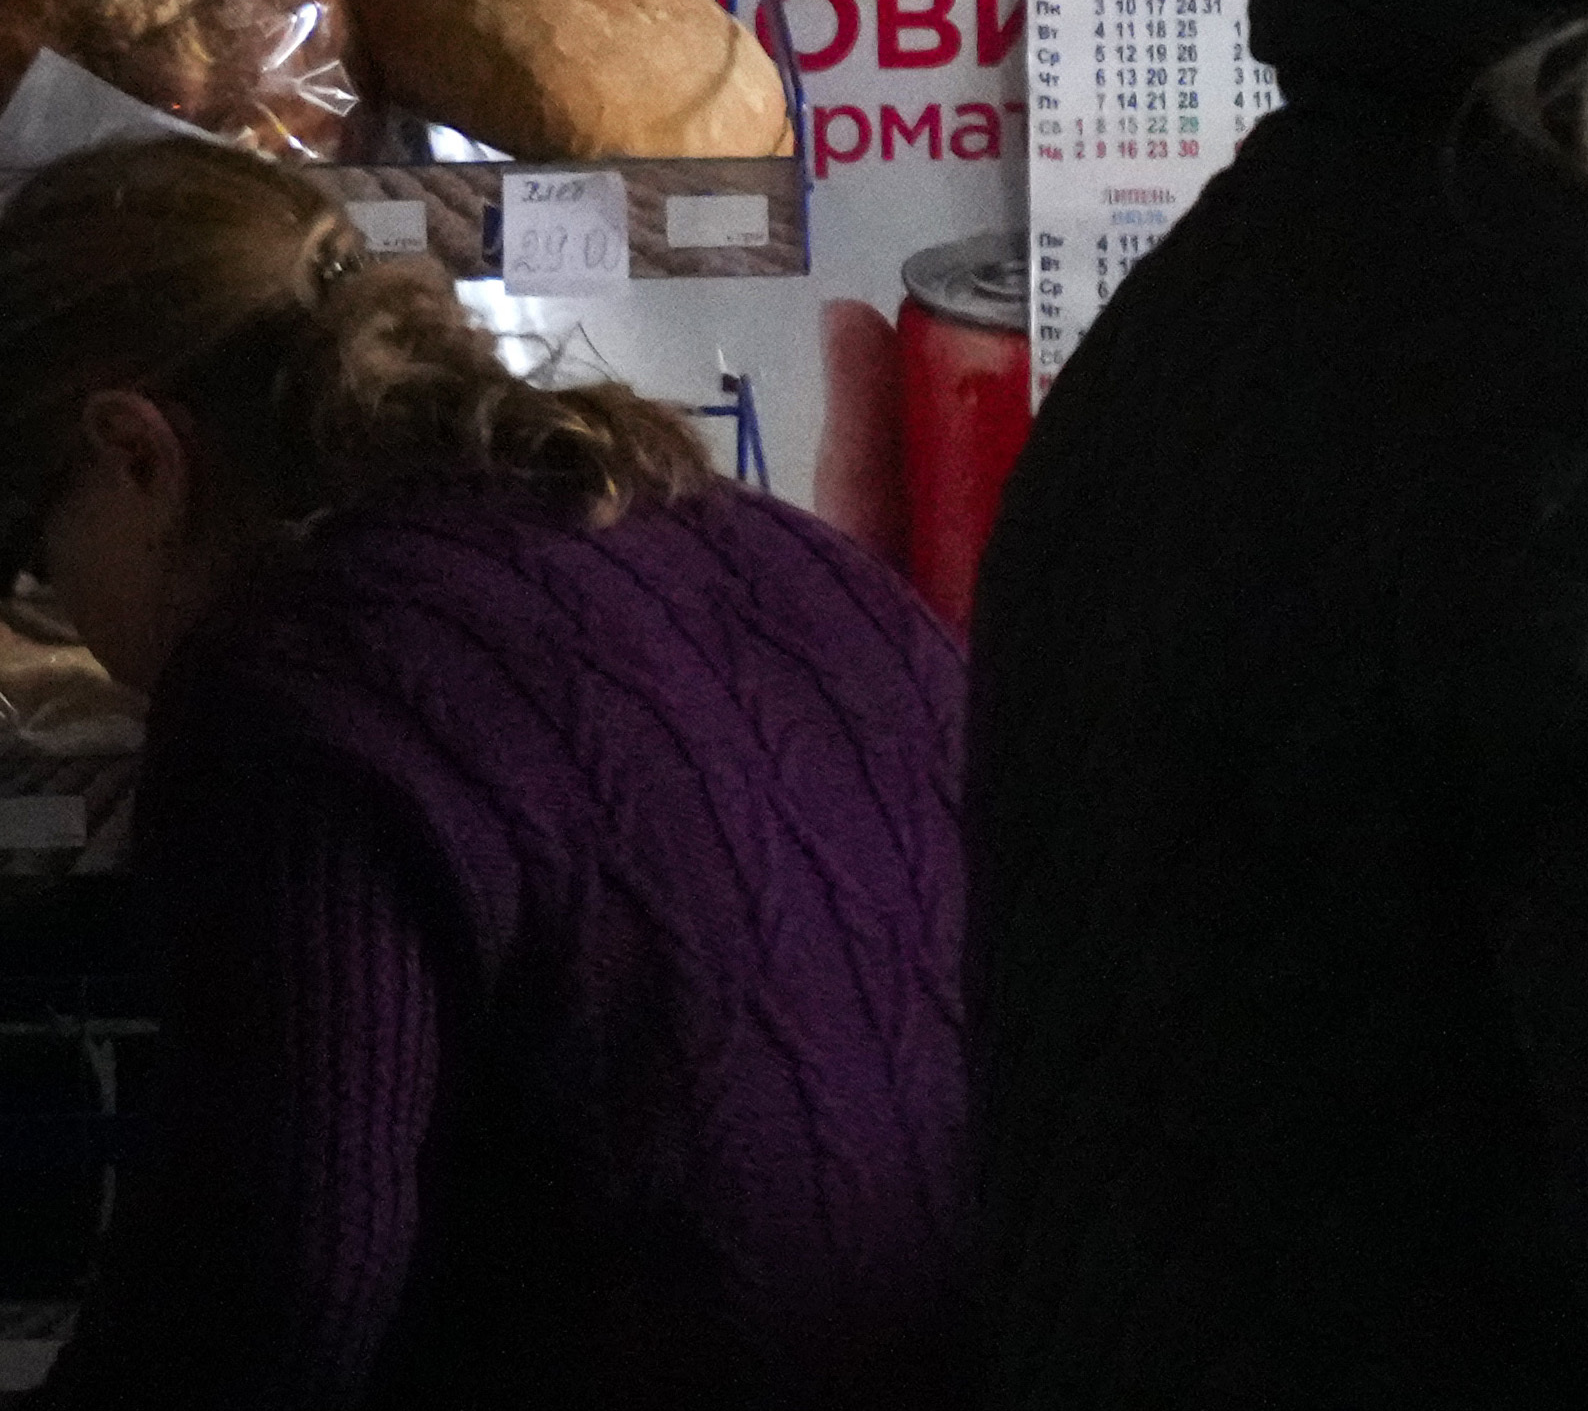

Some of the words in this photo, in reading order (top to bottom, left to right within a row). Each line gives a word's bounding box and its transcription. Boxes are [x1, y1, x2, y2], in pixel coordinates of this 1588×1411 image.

[1036, 0, 1061, 16] Пн
[1094, 21, 1105, 39] 4
[1116, 21, 1135, 39] 11
[1146, 21, 1167, 39] 18
[1177, 21, 1198, 39] 25
[1234, 21, 1242, 37] 1
[1037, 48, 1061, 66] Ср
[1094, 44, 1105, 63] 5
[1116, 44, 1137, 63] 12
[1146, 44, 1168, 63] 19
[1177, 44, 1198, 63] 26
[1233, 44, 1243, 62] 2
[1038, 71, 1060, 87] Чт
[1095, 68, 1106, 86] 6
[1117, 68, 1137, 86] 13
[1147, 68, 1168, 86] 20
[1177, 68, 1199, 86] 27
[1234, 67, 1244, 84] 3
[1253, 67, 1272, 84] 10
[1037, 93, 1060, 110] Пт
[1096, 91, 1106, 109] 7
[1117, 91, 1138, 109] 14
[1147, 91, 1167, 109] 21
[1178, 91, 1199, 109] 28
[1233, 91, 1245, 108] 4
[1253, 91, 1272, 108] 11
[1096, 117, 1106, 134] 8
[1118, 117, 1139, 134] 15
[1147, 117, 1169, 134] 22
[1178, 117, 1200, 134] 29
[1074, 140, 1085, 159] 2
[1096, 140, 1107, 159] 9
[1118, 140, 1138, 159] 16
[1147, 140, 1169, 159] 23
[1178, 140, 1200, 159] 30
[1101, 188, 1177, 205] ЛИПЕНЬ
[1097, 235, 1108, 251] 4
[1120, 234, 1139, 252] 11
[1039, 279, 1063, 296] Ср
